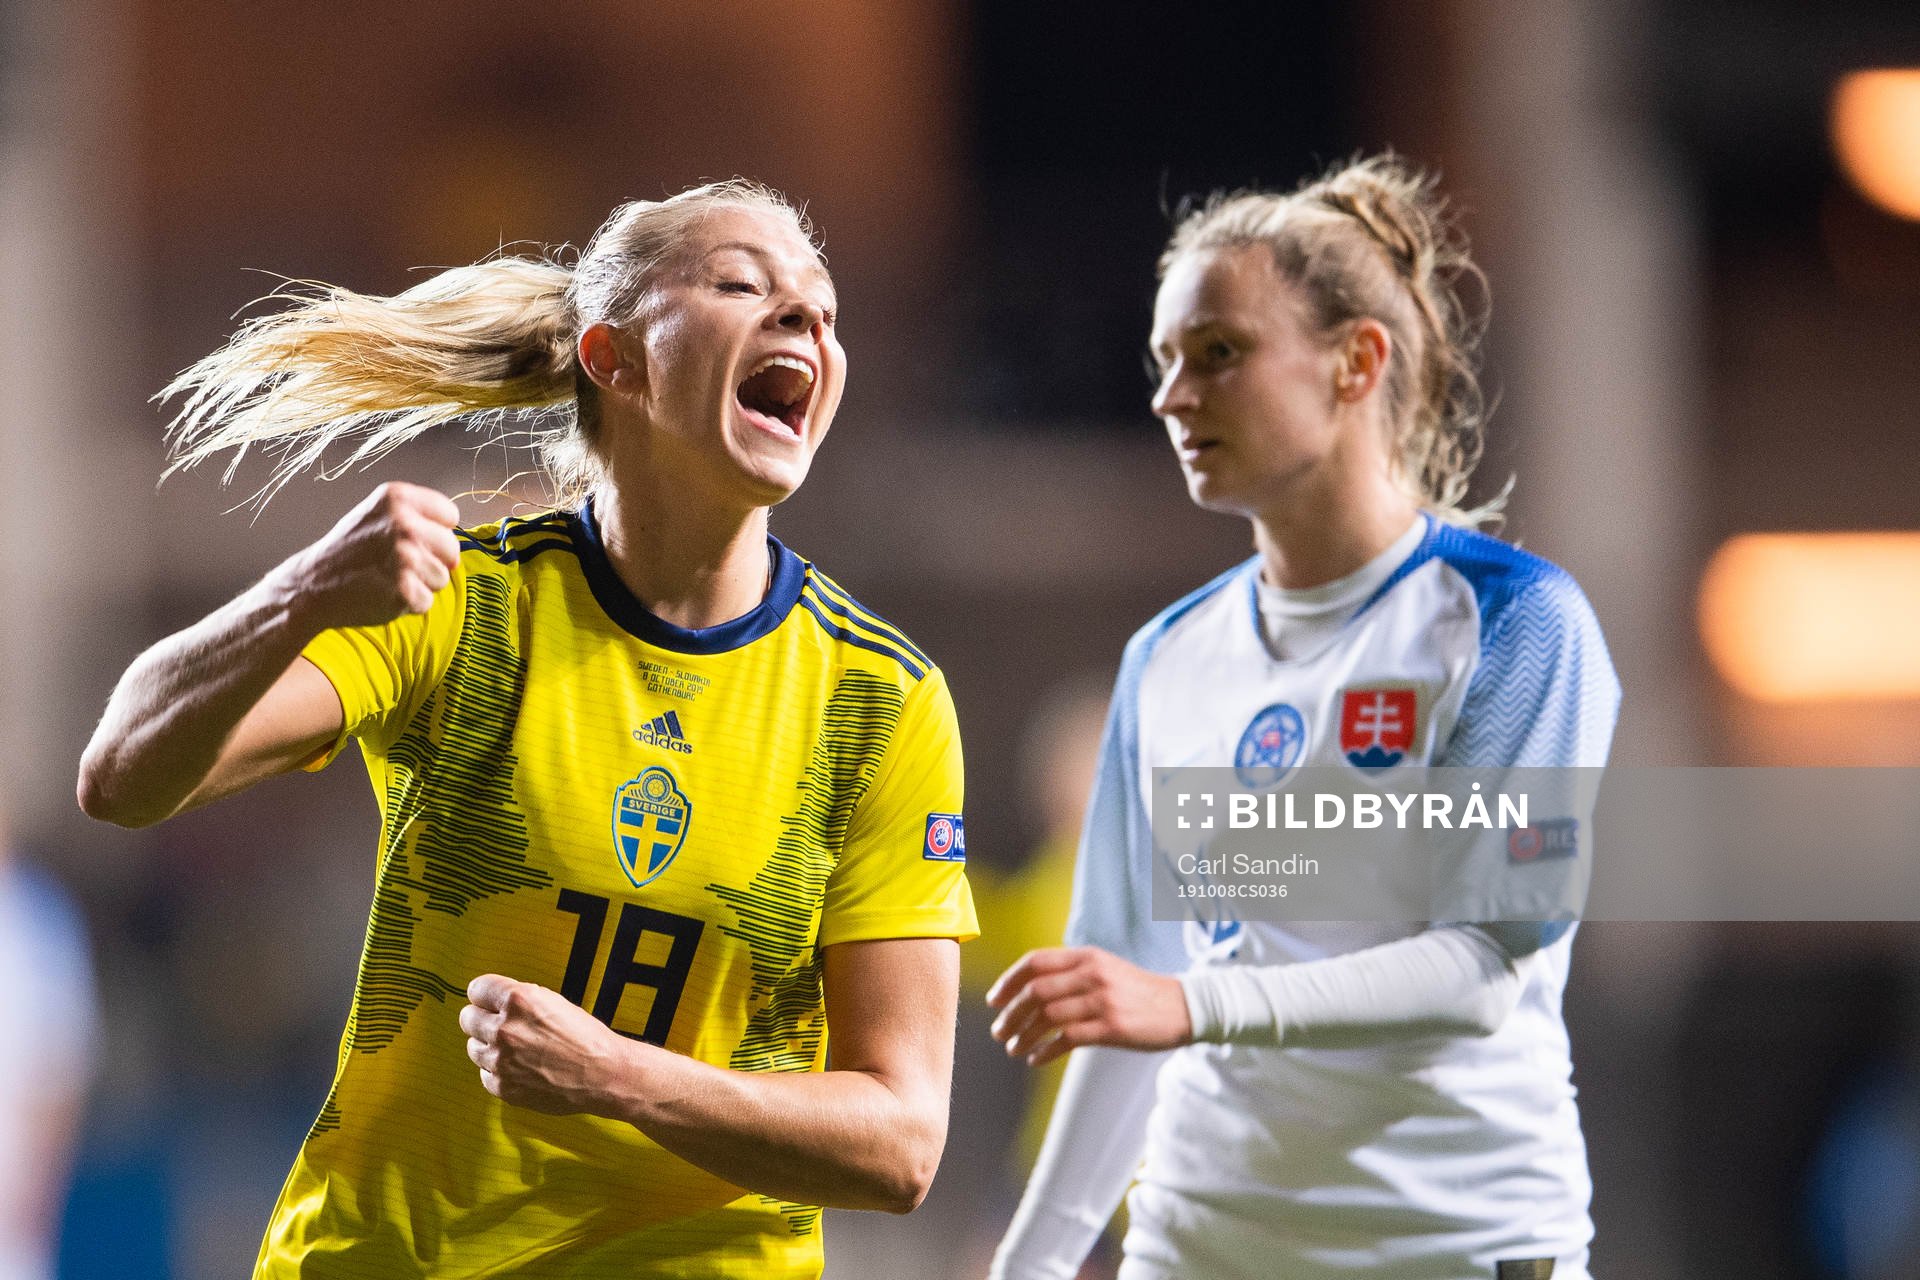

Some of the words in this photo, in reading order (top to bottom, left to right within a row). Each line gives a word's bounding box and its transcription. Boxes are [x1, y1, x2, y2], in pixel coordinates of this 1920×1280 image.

[638, 660, 669, 675] SWEDEN
[650, 673, 685, 689] OCTOBER
[632, 730, 693, 754] adidas
[628, 799, 677, 817] SVERIGE
[556, 888, 705, 1047] 18
